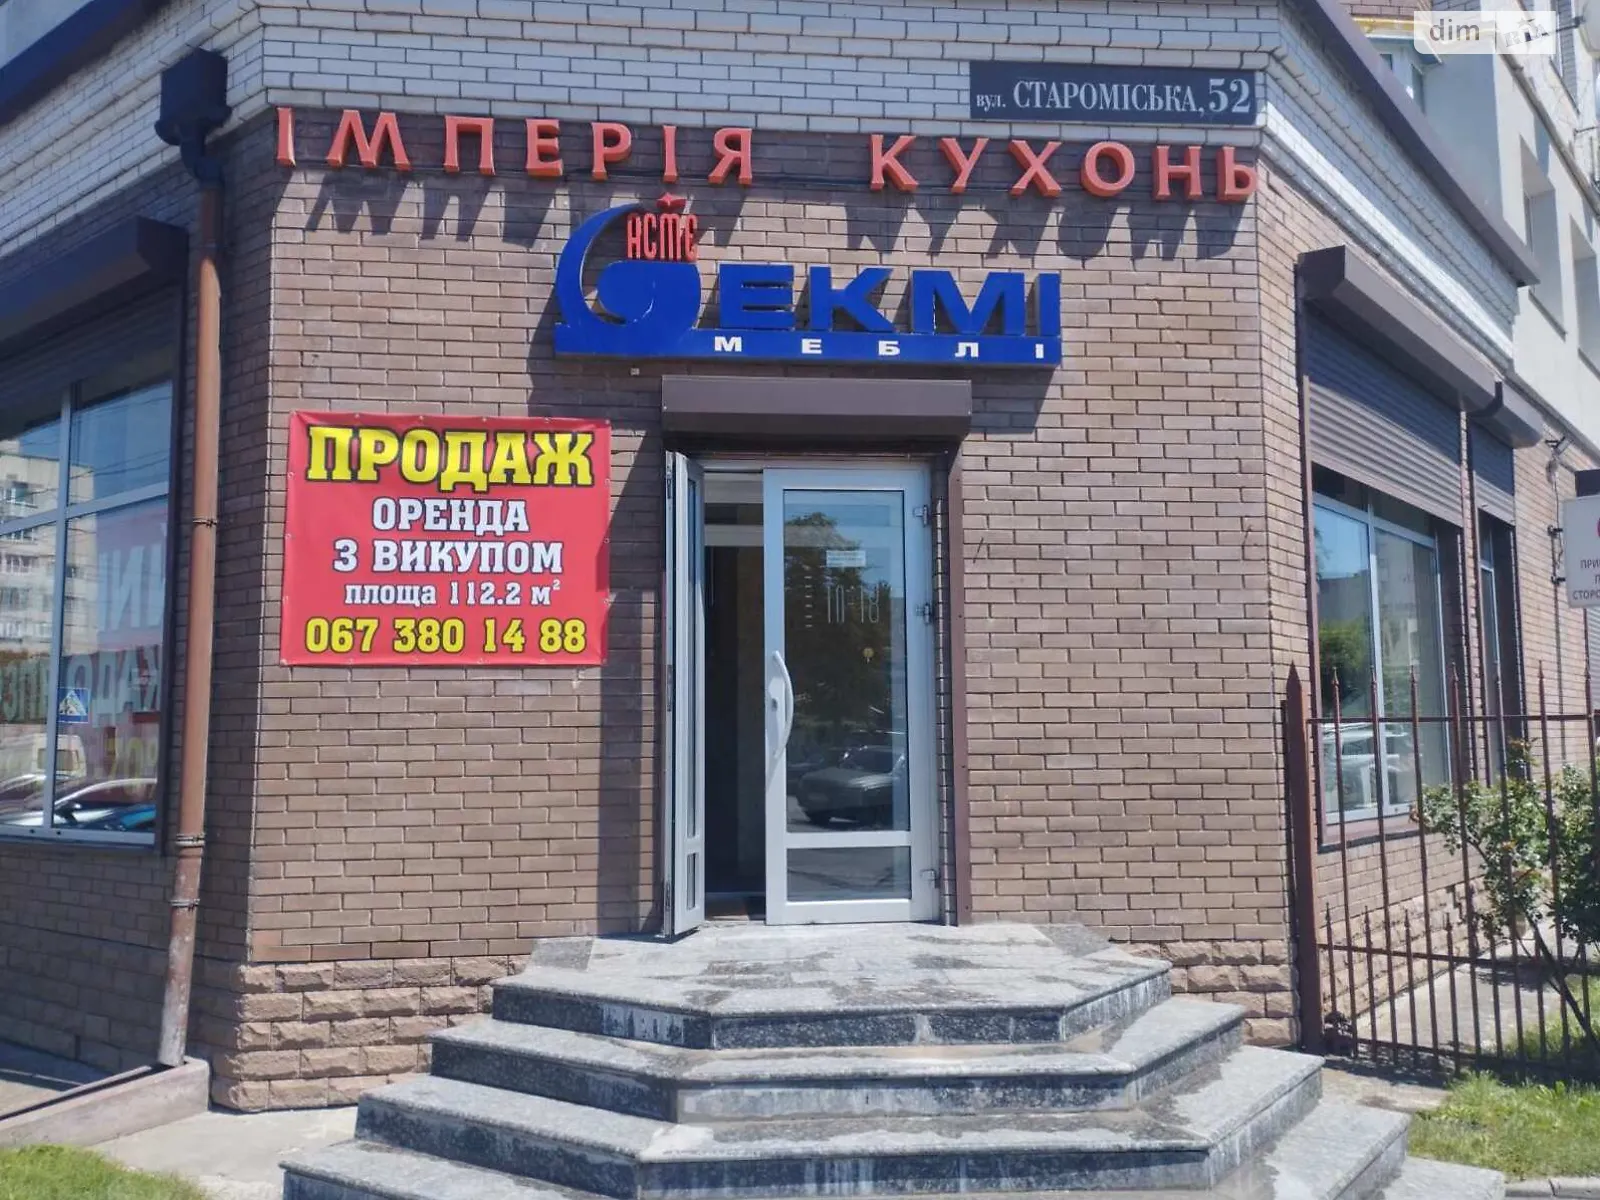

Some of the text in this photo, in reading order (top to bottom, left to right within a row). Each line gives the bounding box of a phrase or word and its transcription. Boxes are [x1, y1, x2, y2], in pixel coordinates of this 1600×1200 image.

[976, 78, 1251, 117] вул. СТАРОМІСЬКА, 52
[276, 107, 1258, 202] ІМПЕРІЯ КУХОНЬ
[713, 336, 1045, 360] МЕБЛІ
[306, 425, 595, 493] ПРОДАЖ
[373, 497, 530, 536] ОРЕНДА
[372, 539, 564, 574] ВИКУПОМ
[344, 582, 437, 607] площа
[450, 582, 522, 606] 112.2
[304, 618, 588, 654] 067 380 14 88
